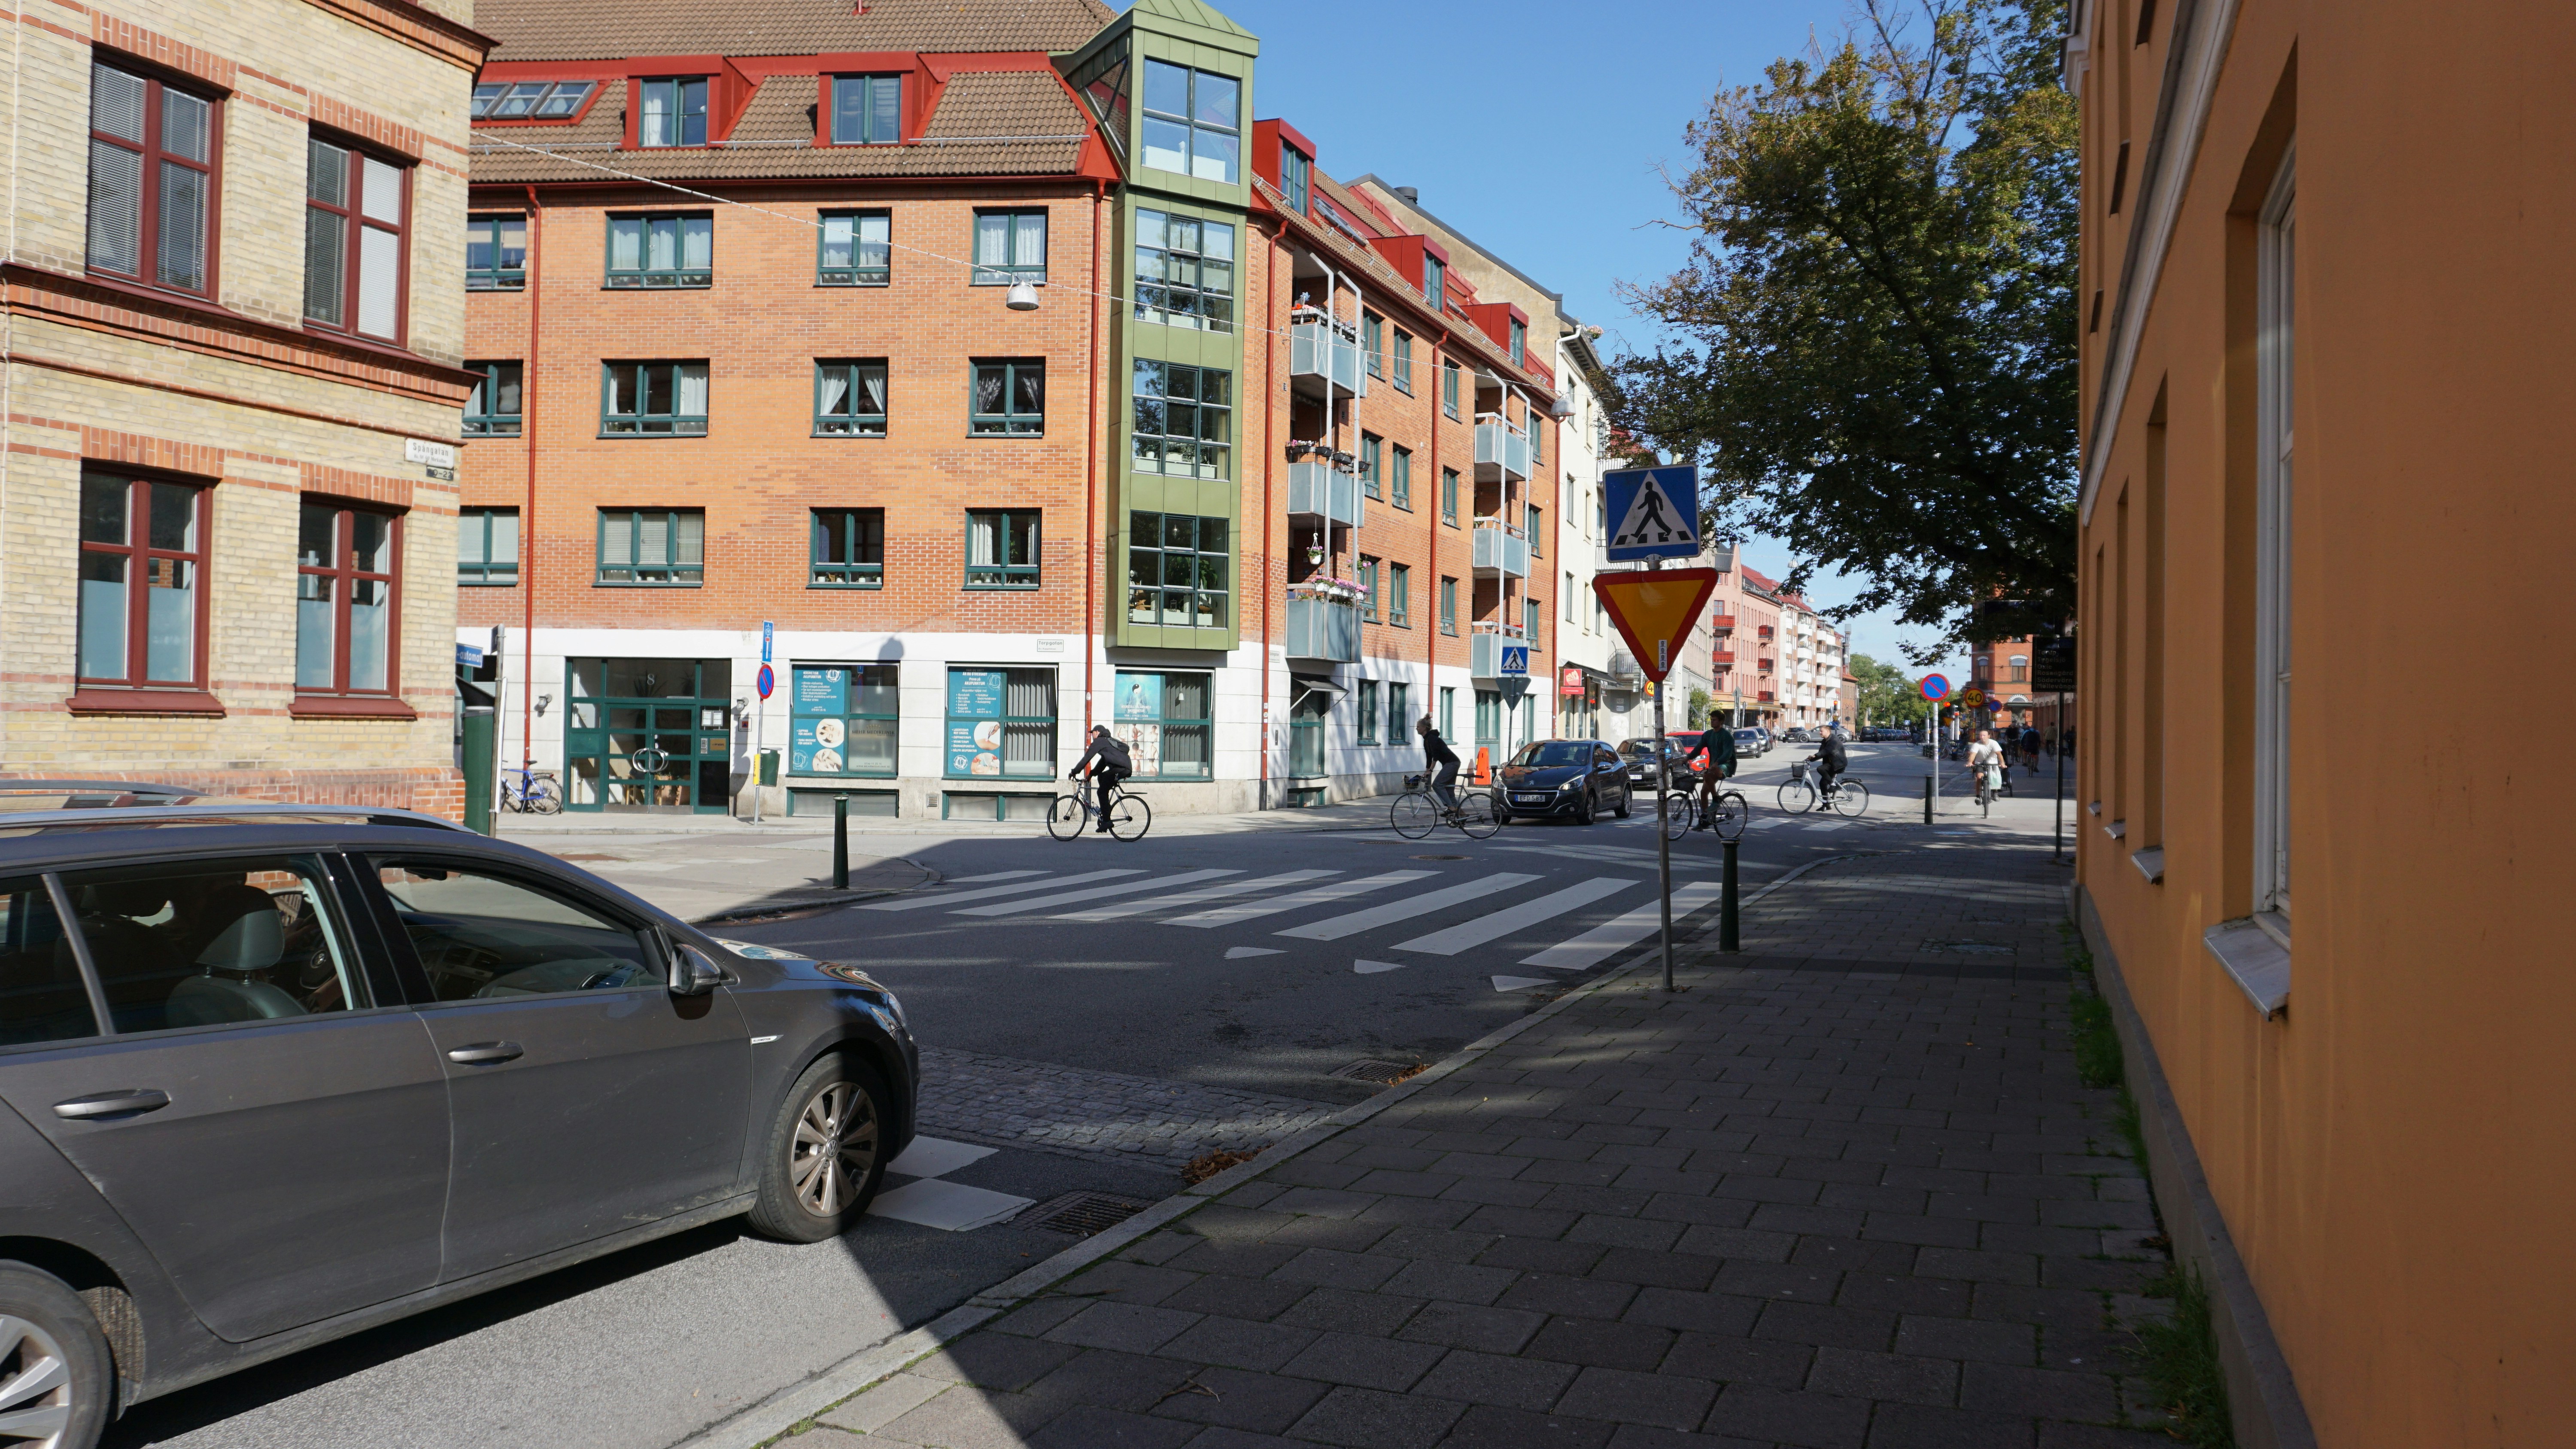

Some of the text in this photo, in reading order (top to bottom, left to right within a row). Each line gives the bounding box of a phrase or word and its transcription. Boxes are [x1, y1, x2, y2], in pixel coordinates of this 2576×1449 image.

[413, 443, 448, 456] Spångatan
[647, 673, 655, 685] 8
[1968, 693, 1982, 703] 40
